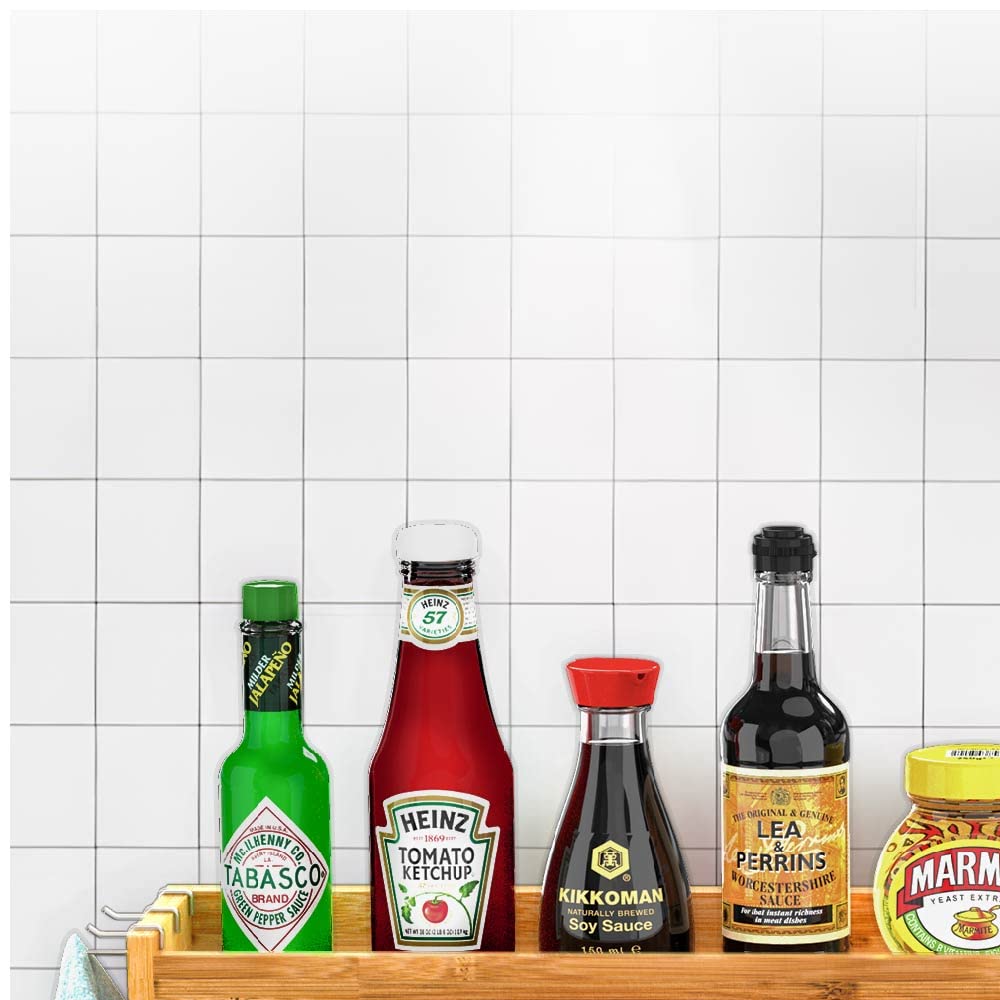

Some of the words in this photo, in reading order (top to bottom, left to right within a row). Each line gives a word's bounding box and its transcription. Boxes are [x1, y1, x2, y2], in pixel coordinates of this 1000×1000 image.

[421, 598, 450, 609] HEINZ
[422, 611, 448, 624] 57
[247, 655, 272, 690] MILDER
[400, 809, 470, 833] HEINZ
[747, 808, 788, 818] ORIGINAL
[790, 809, 797, 817] &
[799, 809, 834, 824] GENUINE
[757, 820, 802, 839] LEA
[424, 834, 445, 843] 1869
[773, 841, 785, 853] &
[398, 846, 475, 865] TOMATO
[736, 851, 826, 872] PERRINS
[224, 863, 321, 890] TABASCO
[403, 865, 472, 881] KETCHUP
[731, 870, 837, 894] WORCESTERSHIRE
[251, 894, 289, 904] BRAND
[558, 887, 664, 906] KIKKOMAN
[759, 895, 801, 906] SAUCE
[930, 894, 965, 905] YEAST
[233, 889, 254, 918] GREEN
[253, 911, 286, 926] PEPPER
[287, 889, 309, 918] SAUCE
[567, 908, 615, 917] NATURALLY
[617, 908, 655, 917] BREWED
[766, 907, 792, 916] instant
[569, 918, 598, 934] Soy
[602, 919, 653, 932] Sauce
[905, 913, 938, 949] CONTAINS
[957, 923, 993, 936] MARMITE
